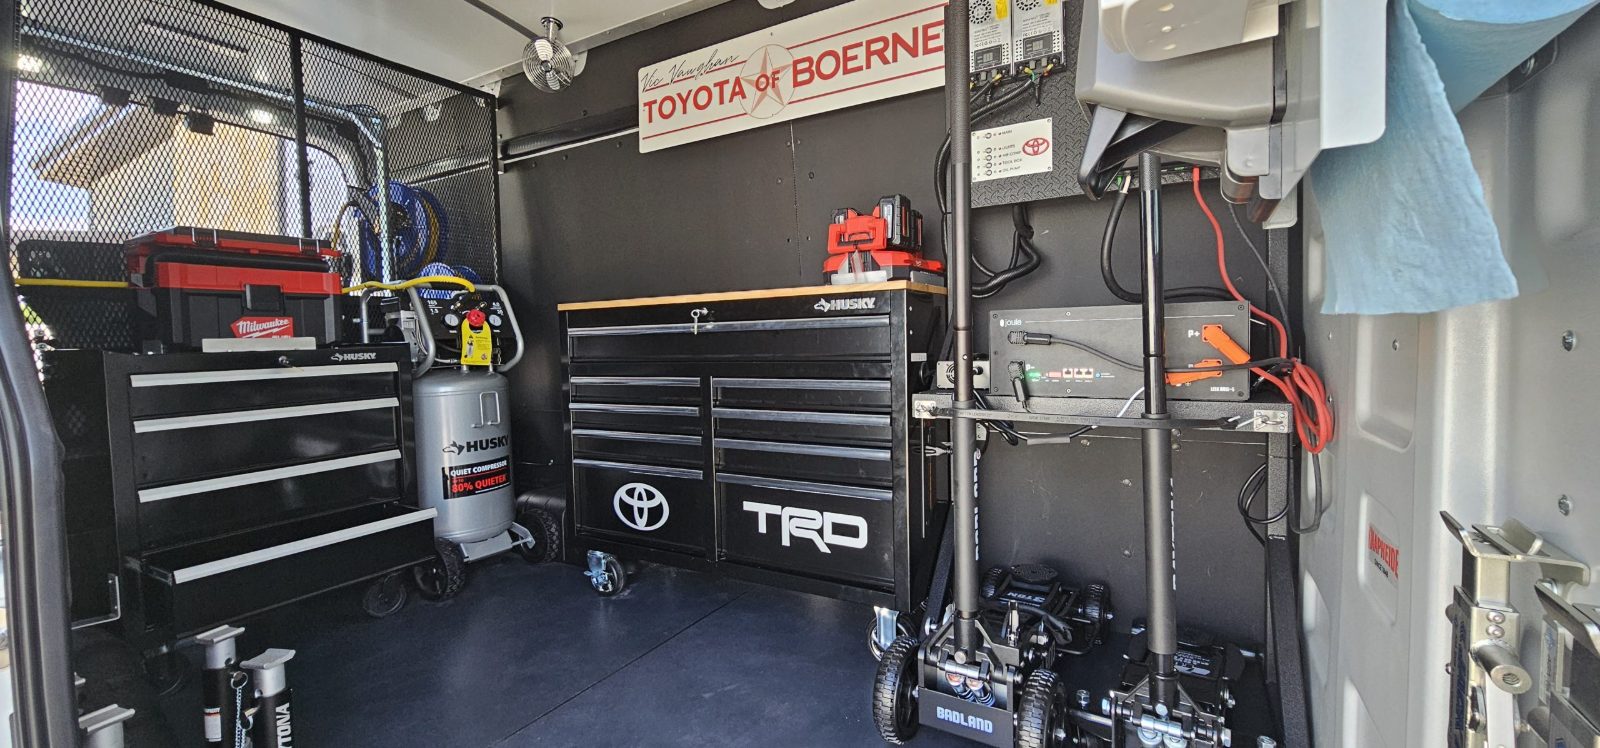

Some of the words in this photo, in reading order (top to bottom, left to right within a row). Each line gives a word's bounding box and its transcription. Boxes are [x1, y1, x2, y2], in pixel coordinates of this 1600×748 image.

[641, 69, 663, 93] Vic
[668, 49, 739, 85] Vaughan
[643, 76, 747, 124] TOYOTA
[754, 71, 780, 93] OF
[792, 19, 945, 88] BOERNE
[830, 297, 876, 310] HUSKY
[236, 318, 289, 335] Milwaukee
[1005, 318, 1022, 327] joule
[343, 352, 377, 361] HUSKY
[466, 435, 509, 452] HUSKY
[450, 467, 472, 477] QUIET
[452, 482, 473, 493] 80%
[475, 474, 506, 489] QUIETER
[742, 500, 868, 554] TRD
[276, 702, 292, 748] TONA
[936, 706, 993, 734] BADLAND
